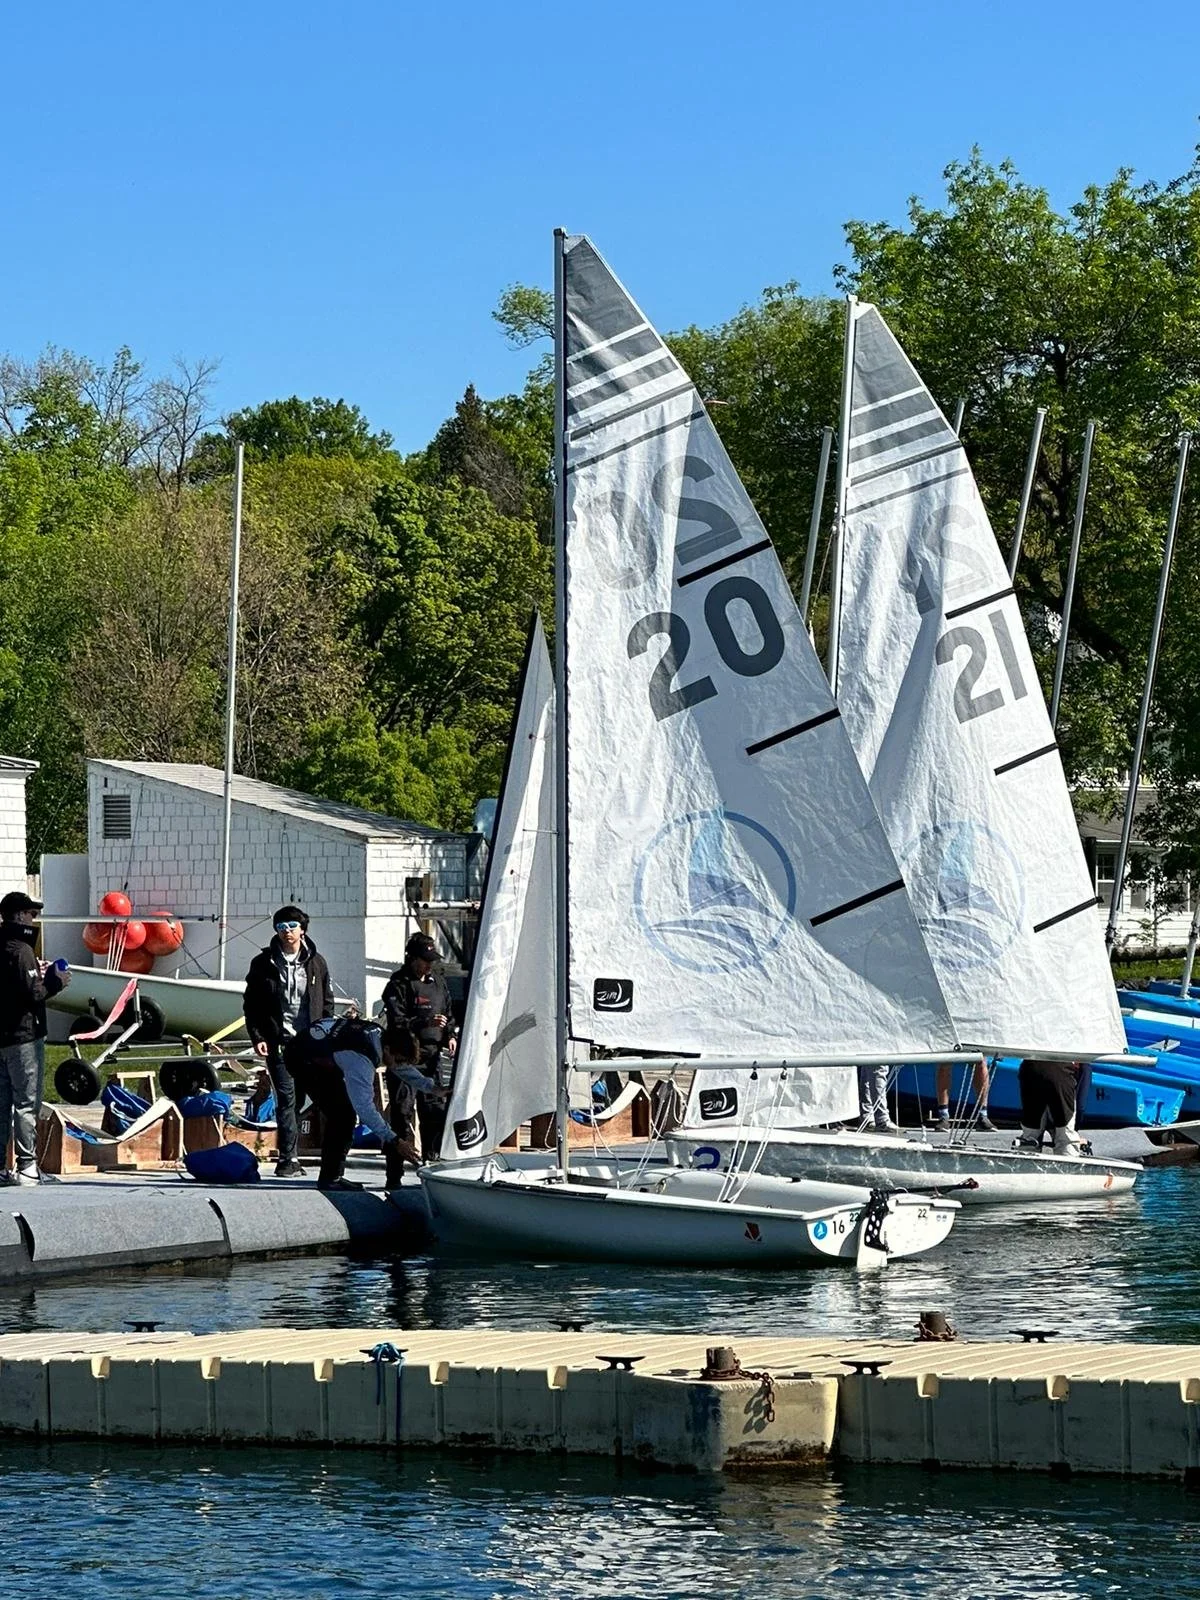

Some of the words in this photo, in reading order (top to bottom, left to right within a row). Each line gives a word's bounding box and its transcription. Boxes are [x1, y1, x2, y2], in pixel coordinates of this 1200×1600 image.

[627, 575, 785, 722] 20
[935, 609, 1028, 724] 21
[832, 1219, 845, 1235] 16
[918, 1208, 928, 1219] 22
